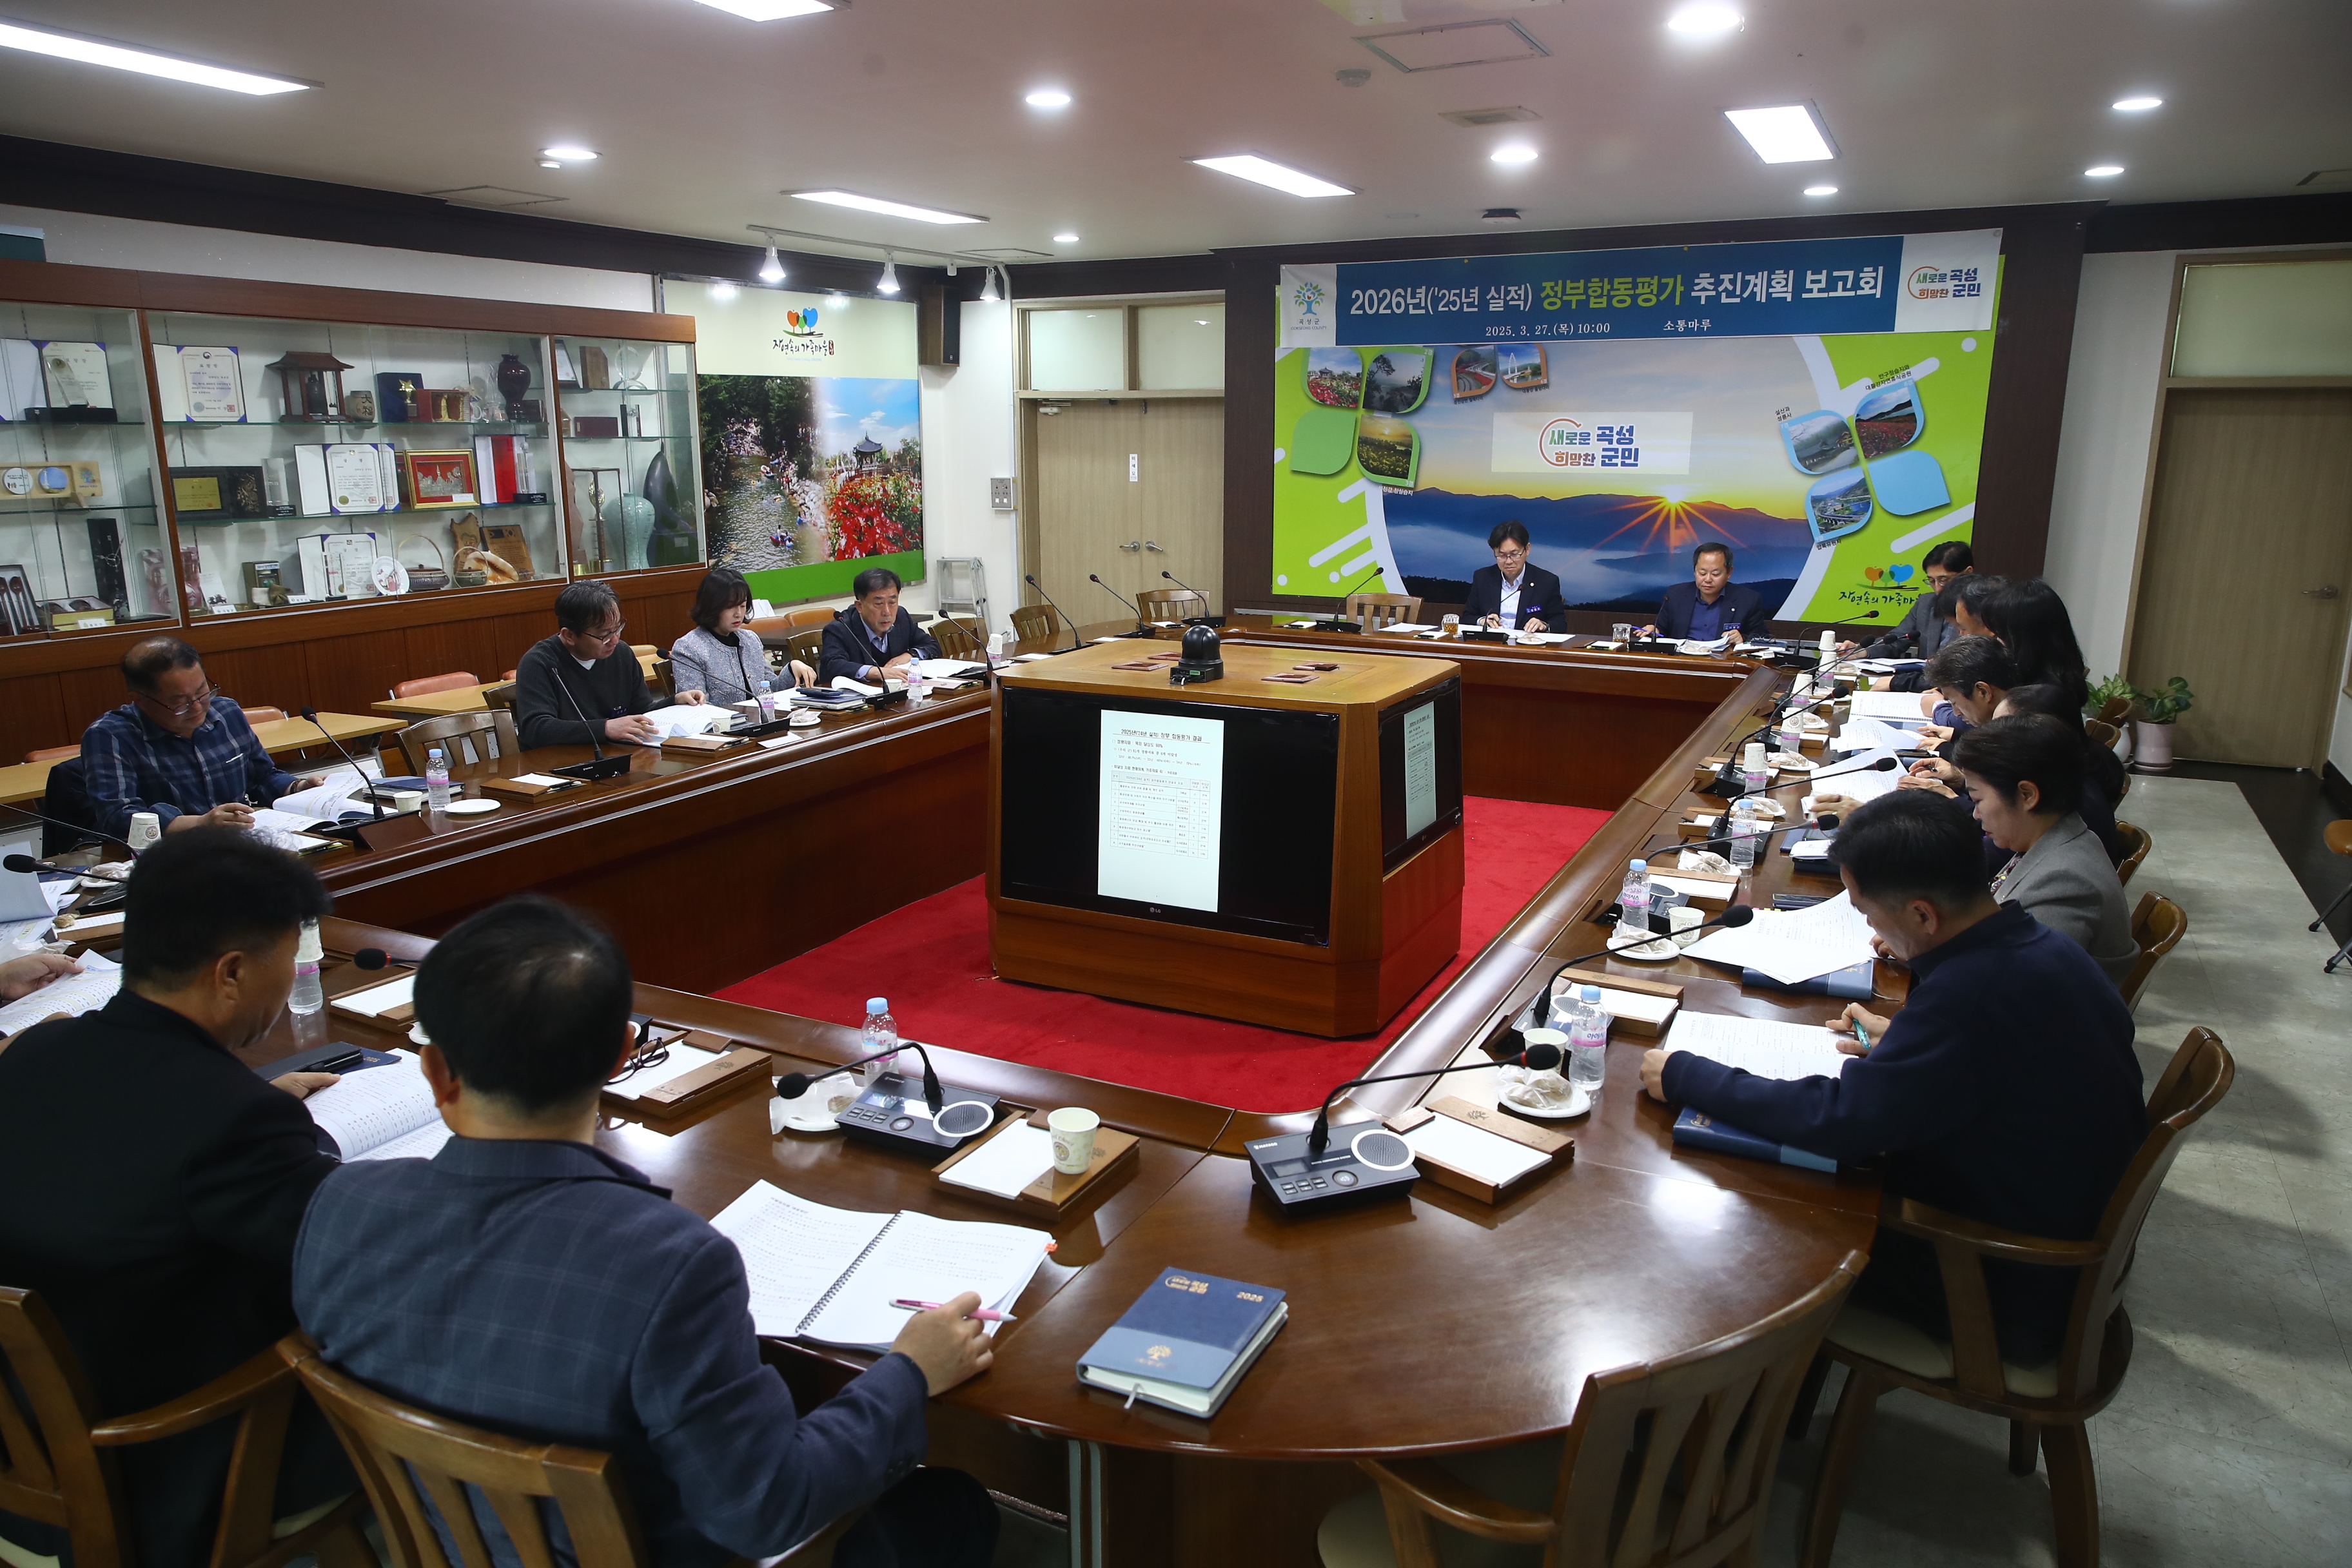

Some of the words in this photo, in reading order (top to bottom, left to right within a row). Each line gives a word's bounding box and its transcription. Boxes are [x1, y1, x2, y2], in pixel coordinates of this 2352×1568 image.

[1916, 273, 1947, 284] 새로운
[1950, 268, 1978, 282] 곡성
[1351, 286, 1478, 315] 2026년('25년
[1486, 283, 1533, 311] 실적)
[1540, 274, 1684, 310] 정부합동평가
[1691, 270, 1794, 305] 추진계획
[1801, 266, 1884, 299] 보고회
[1918, 288, 1949, 299] 희망찬
[1952, 282, 1981, 299] 군민
[1485, 326, 1515, 337] 2025.
[1578, 323, 1610, 333] 10:00
[1663, 319, 1711, 332] 소통마루
[772, 338, 799, 355] 자연속의
[801, 339, 828, 357] 가족마을
[1549, 430, 1591, 445] 새로운
[1596, 426, 1634, 445] 곡성
[1554, 451, 1596, 466] 희망찬
[1601, 447, 1640, 467] 군민
[1839, 591, 1879, 605] 자연속의
[1237, 1291, 1264, 1302] 2025
